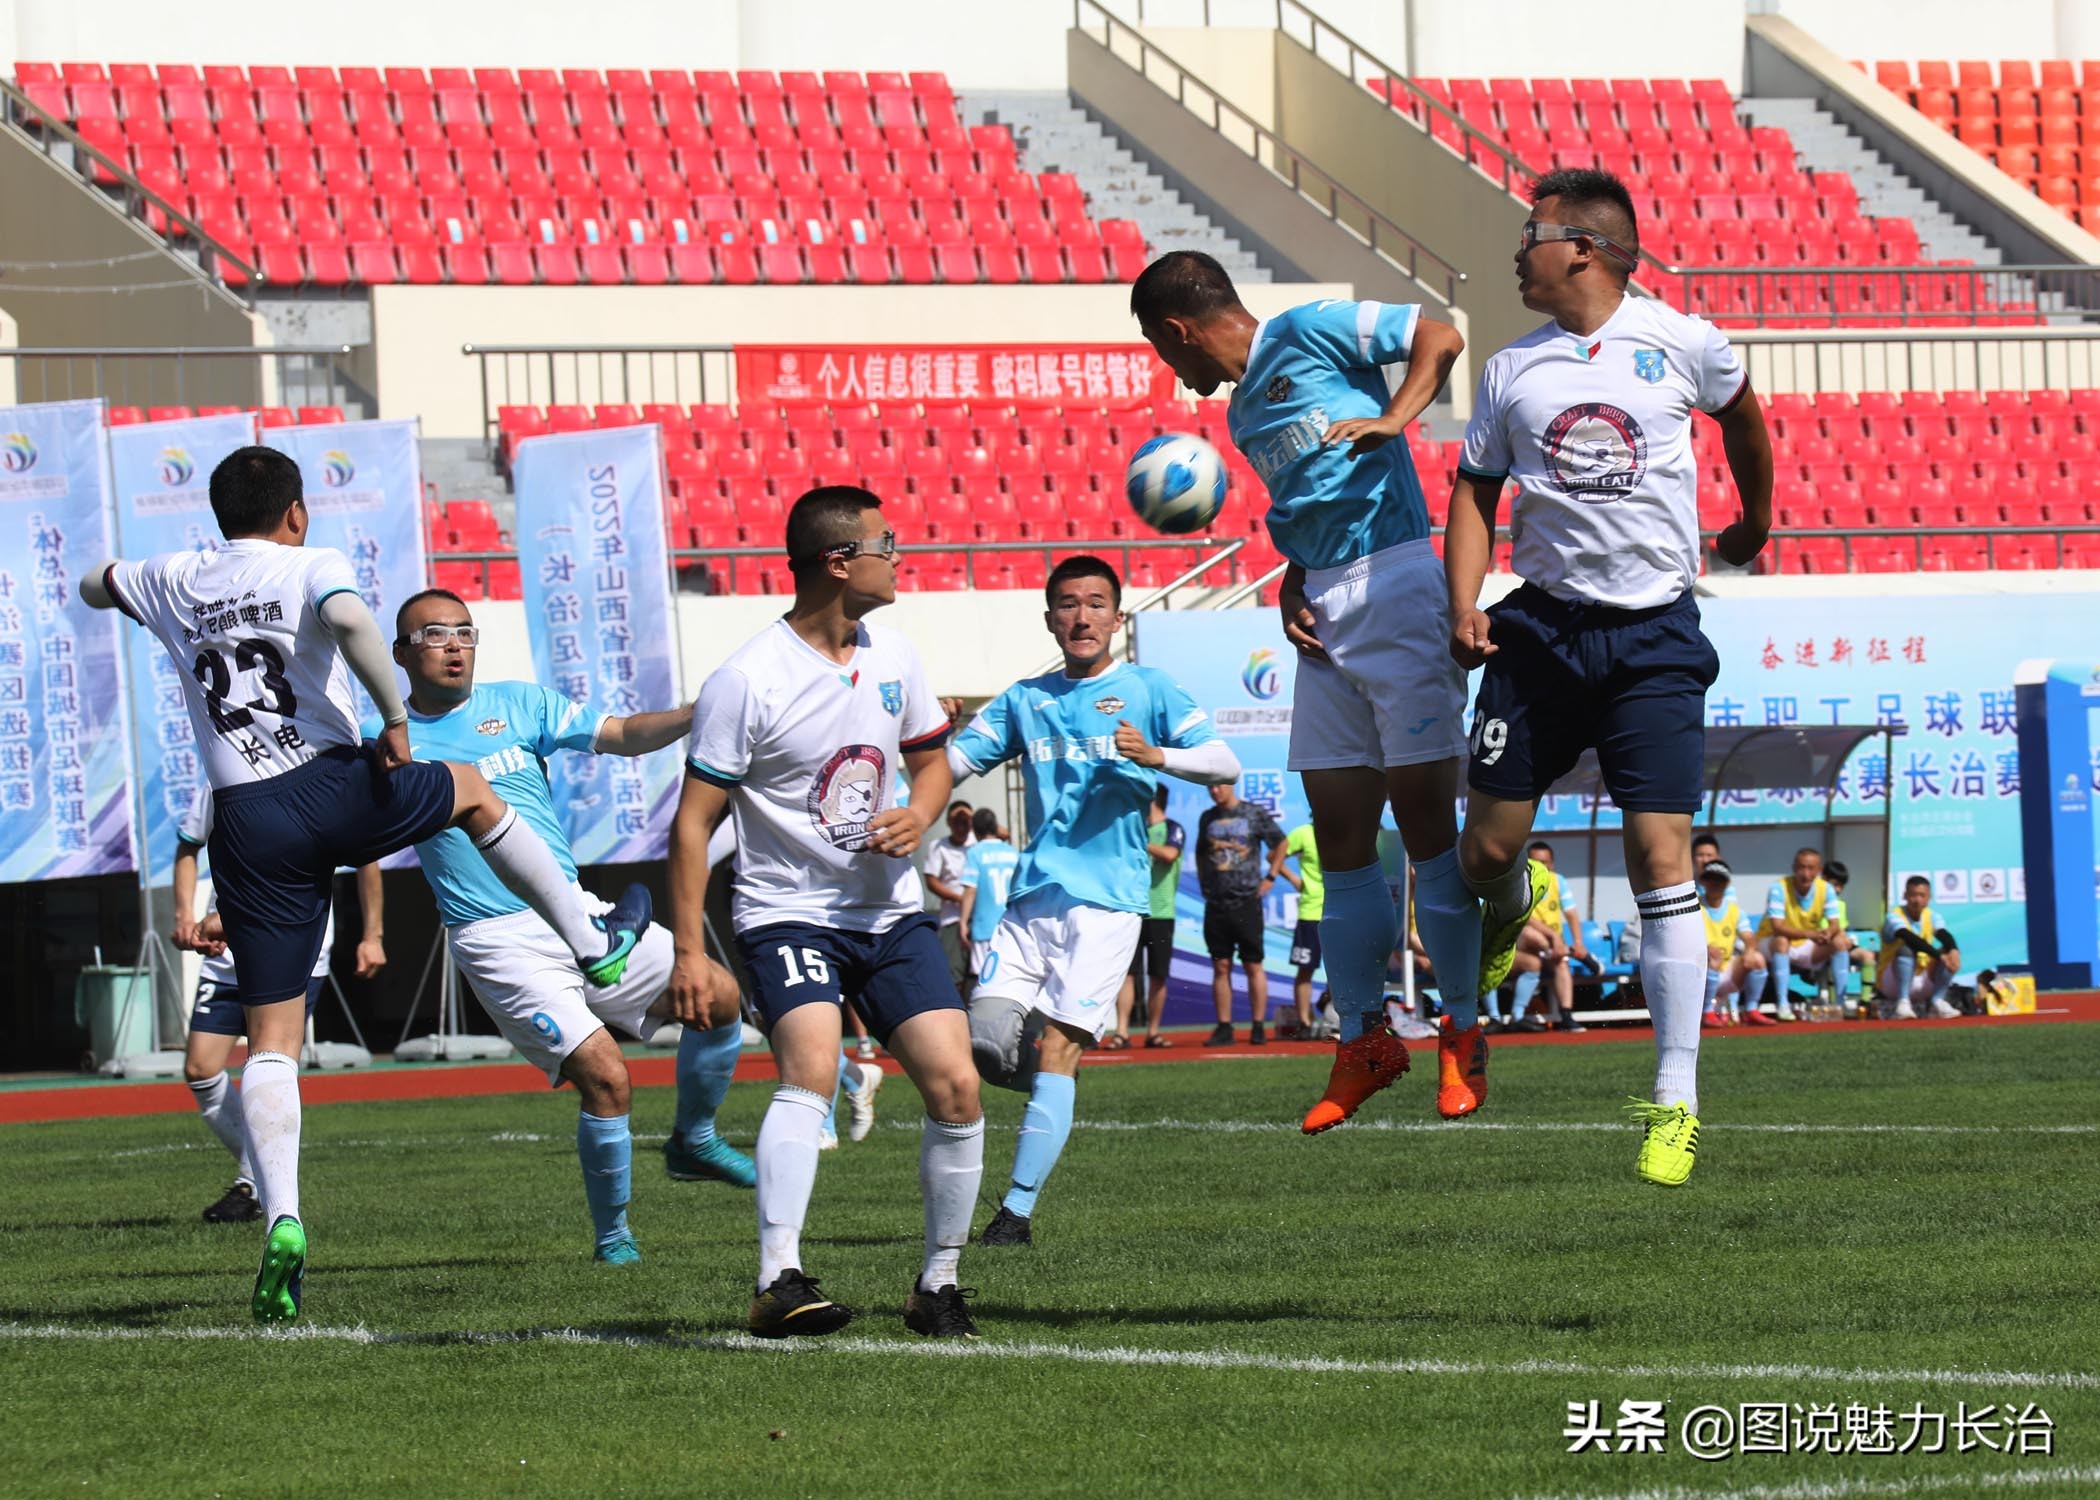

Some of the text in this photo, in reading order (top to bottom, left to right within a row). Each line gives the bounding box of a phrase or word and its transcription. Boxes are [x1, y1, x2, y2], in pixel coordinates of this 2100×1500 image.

[816, 352, 1153, 400] 个人信息很重要 密码账号保管好
[1552, 405, 1588, 431] CRAFT
[1602, 475, 1630, 487] CAT
[1760, 636, 1928, 669] 奋进新征程
[193, 638, 297, 735] 23
[241, 723, 305, 766] 长电
[1243, 771, 1283, 818] 暨
[834, 823, 866, 836] IRON
[777, 945, 830, 988] 15
[531, 1012, 562, 1048] 9
